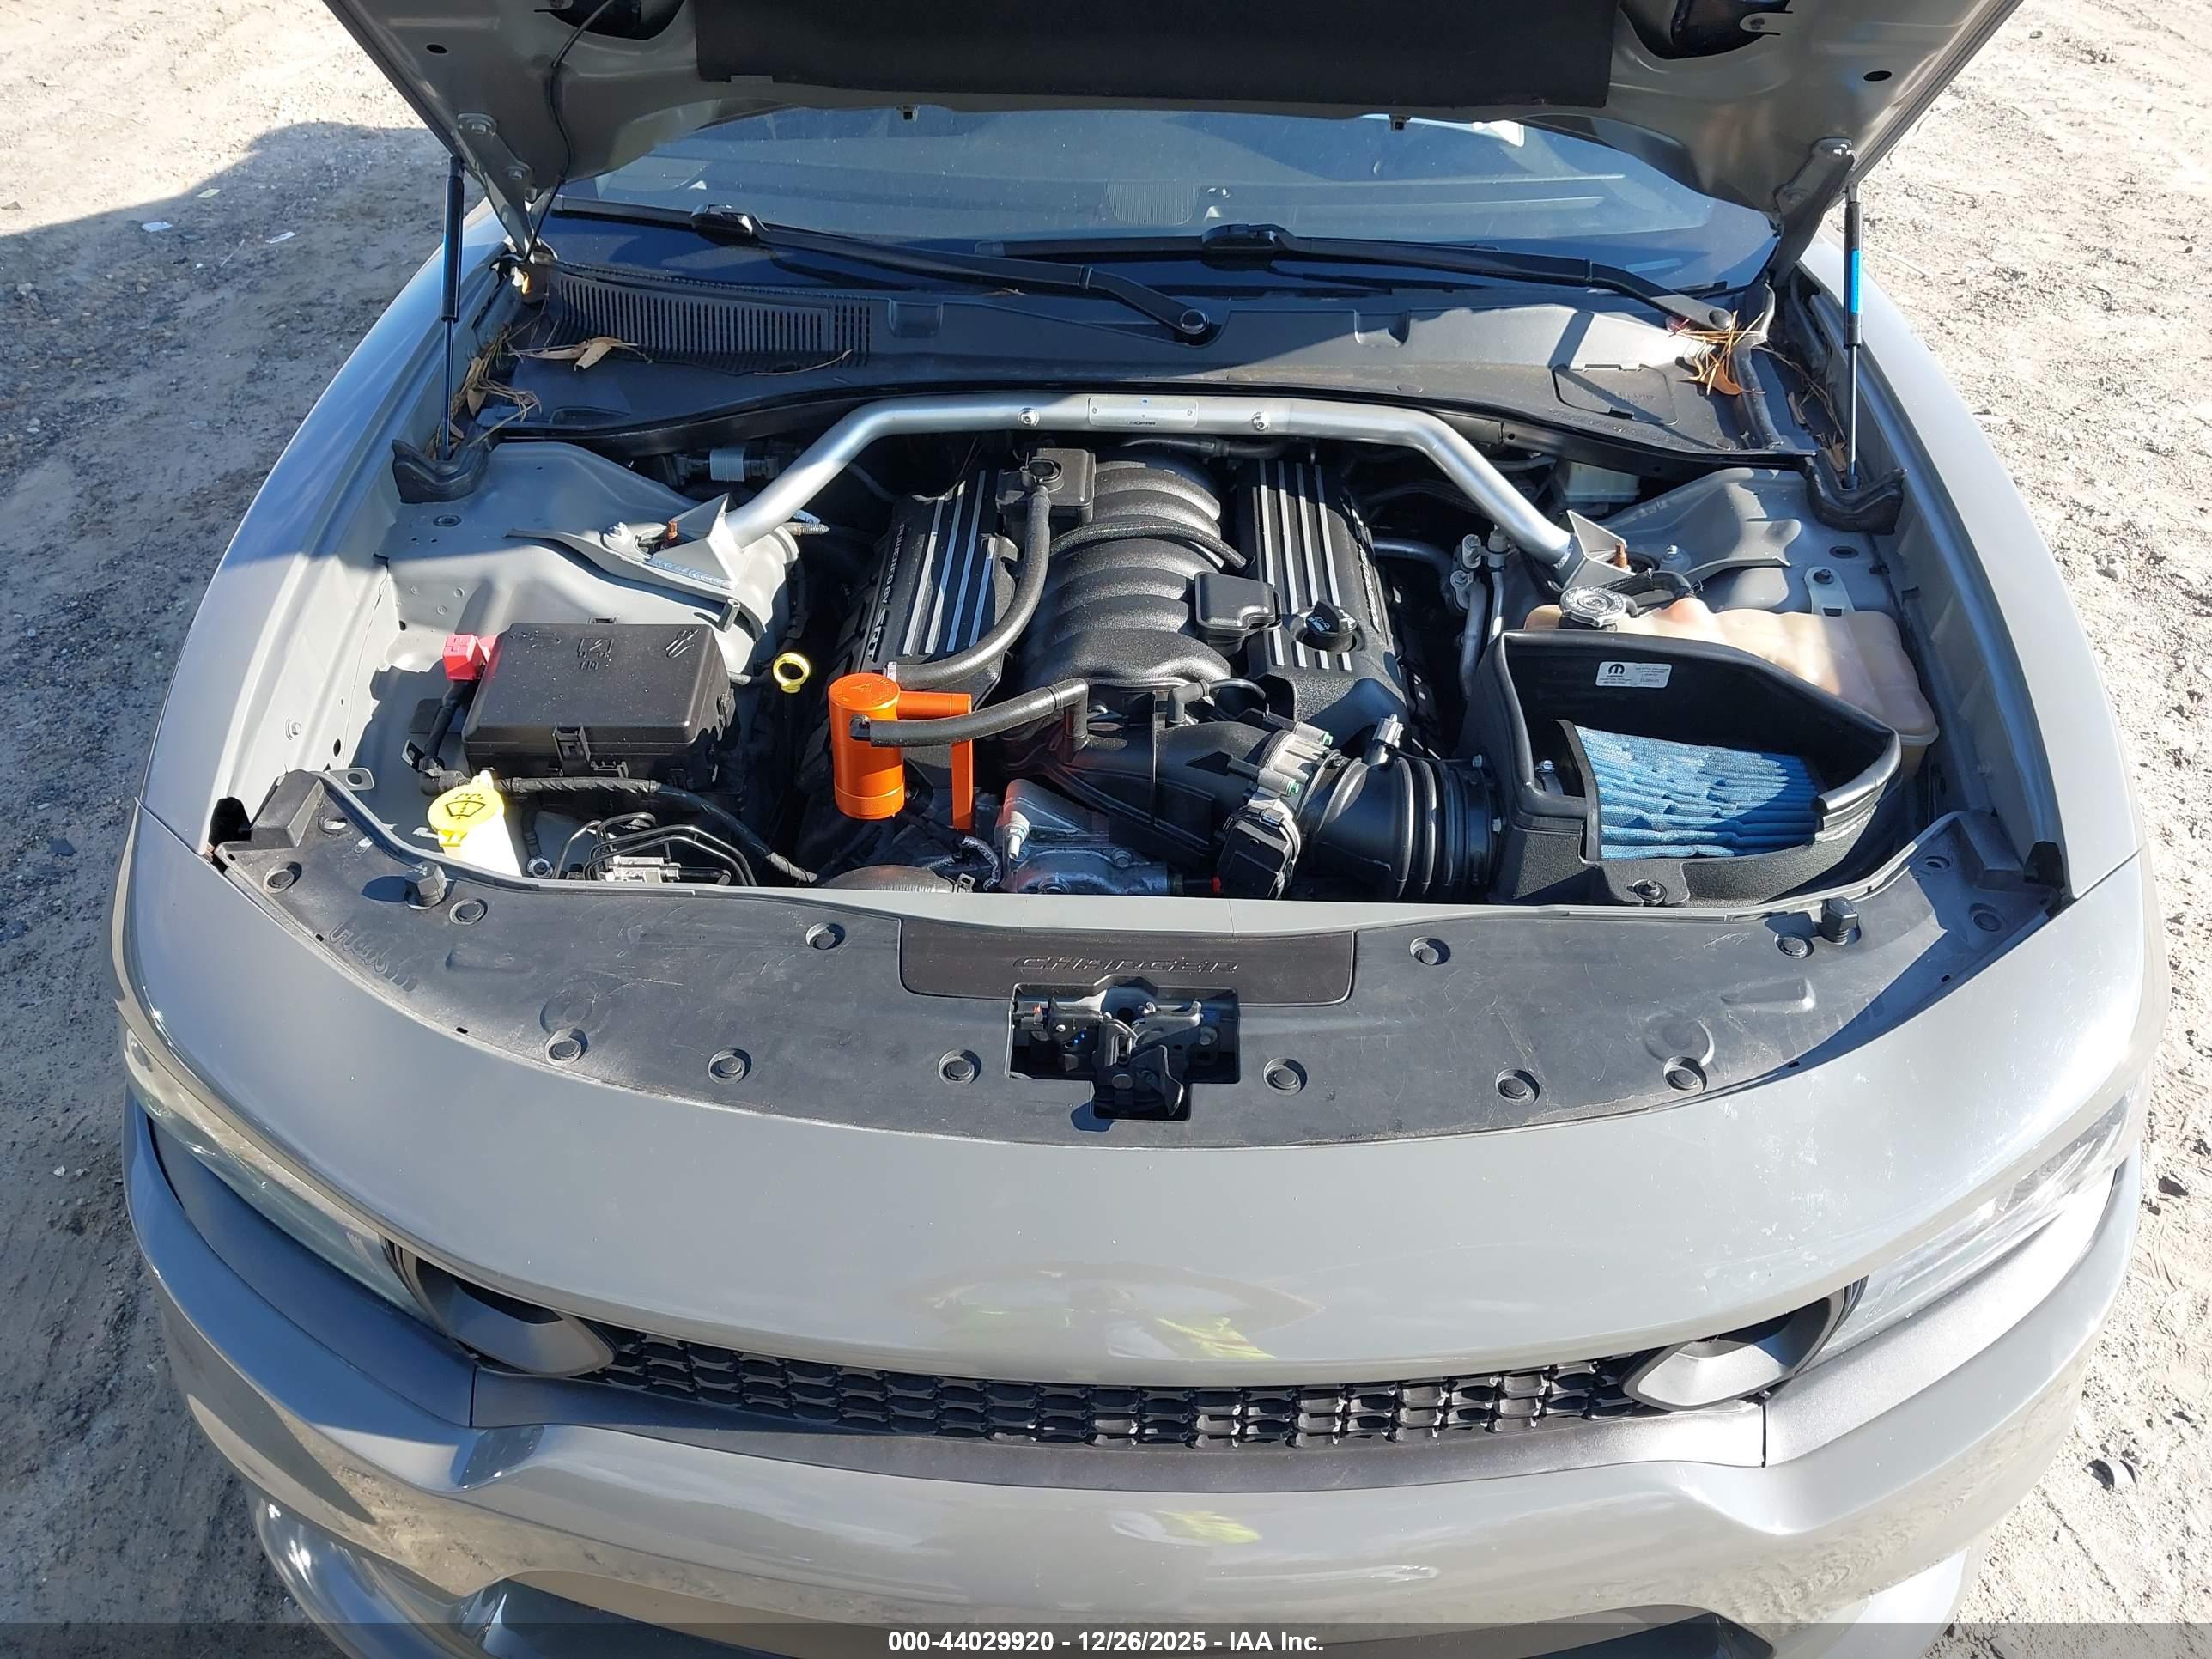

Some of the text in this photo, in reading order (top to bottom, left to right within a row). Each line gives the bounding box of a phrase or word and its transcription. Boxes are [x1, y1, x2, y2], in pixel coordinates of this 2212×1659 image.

[867, 524, 904, 660] POWERED BY SRT
[1013, 955, 1238, 973] CHARGER
